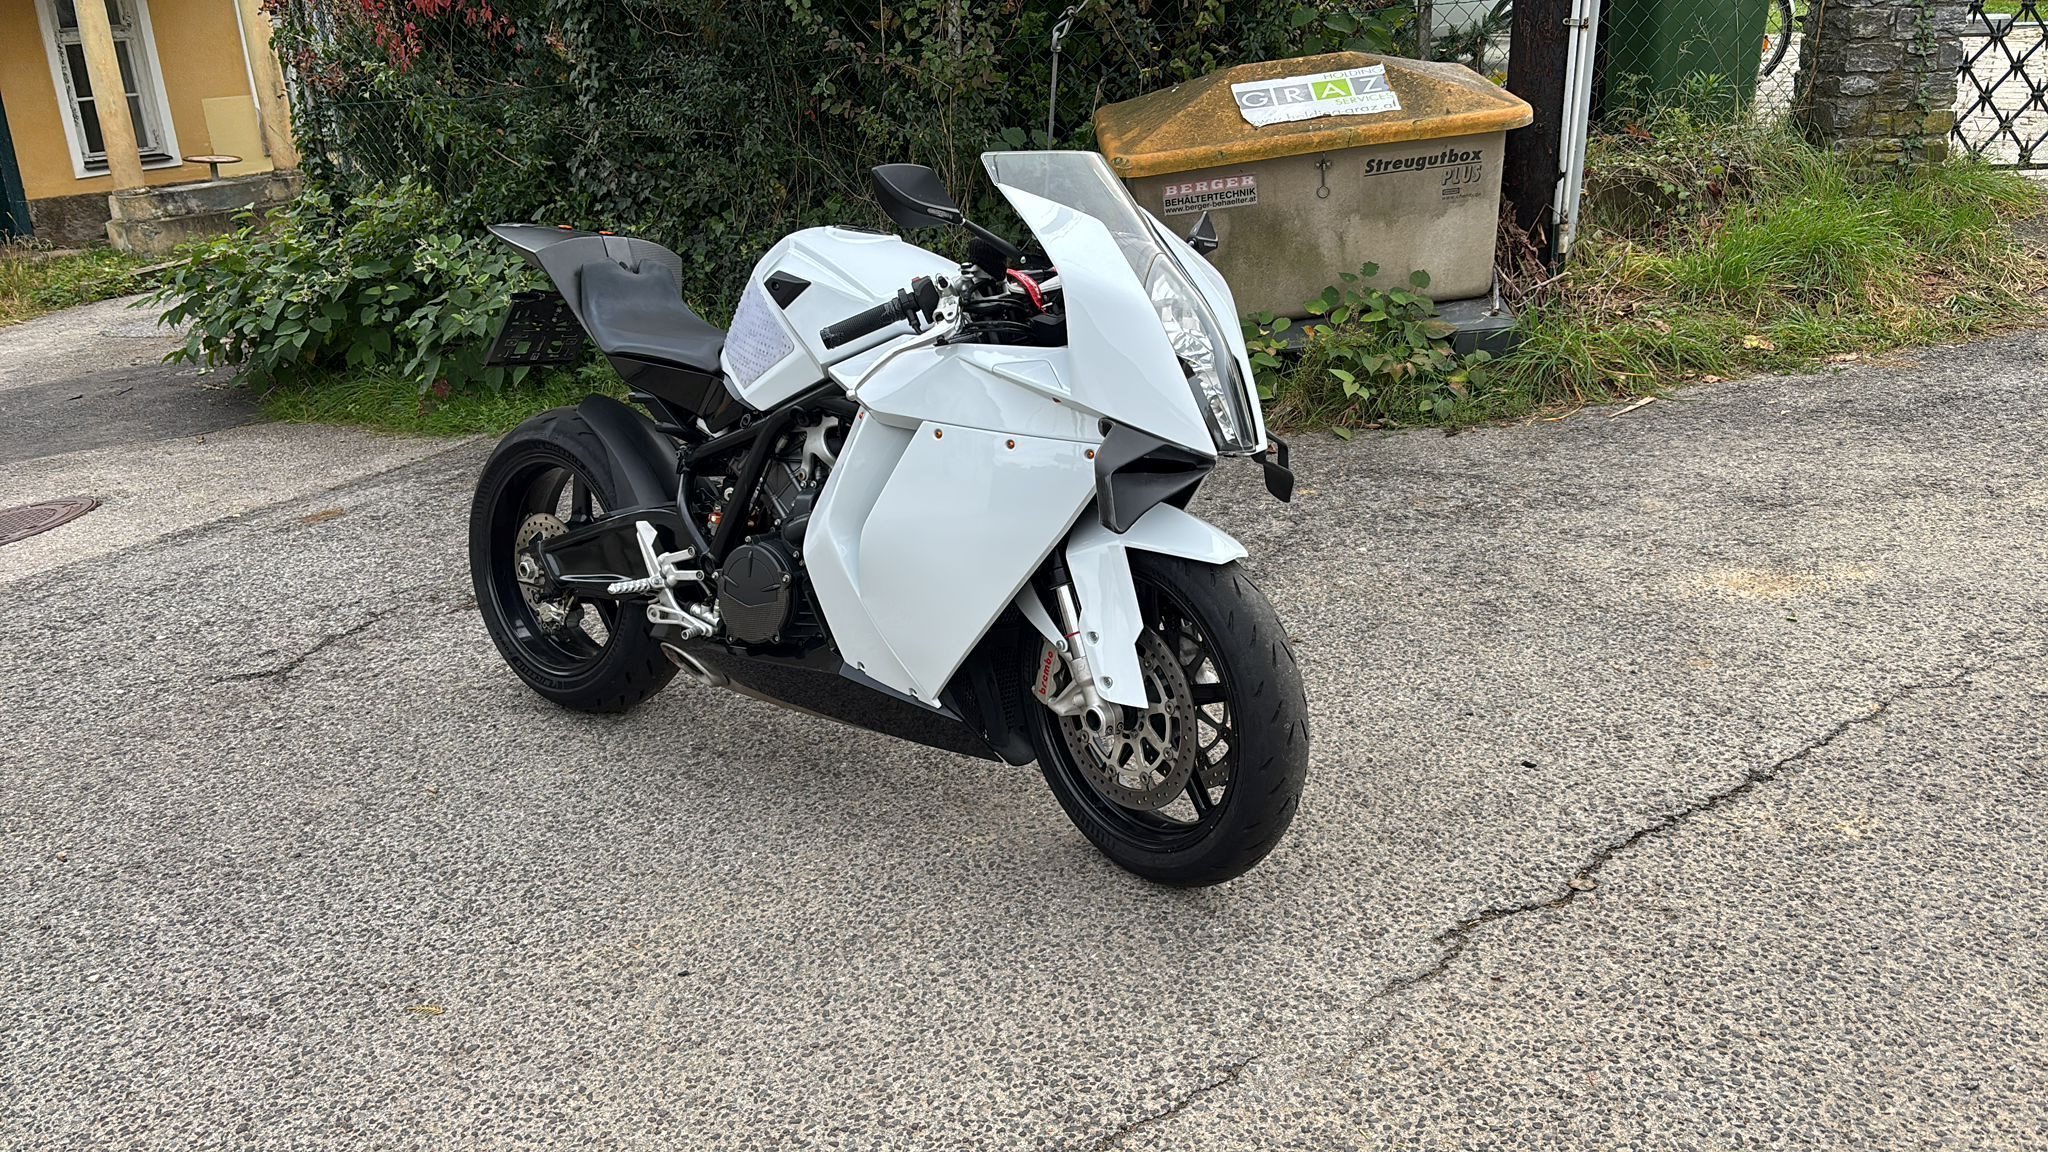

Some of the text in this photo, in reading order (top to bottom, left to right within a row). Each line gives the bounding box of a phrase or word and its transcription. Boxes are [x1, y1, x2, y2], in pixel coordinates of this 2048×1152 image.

[1323, 66, 1384, 80] HOLDING
[1241, 77, 1383, 108] GRAZ
[1335, 93, 1394, 106] SERVICES
[1365, 149, 1482, 174] Streugutbox
[1165, 176, 1255, 195] BERGER
[1441, 164, 1482, 186] PLUS
[1164, 195, 1257, 214] www.berger-behaelter.at
[1165, 187, 1256, 208] BEHÄLTERTECHNIK
[1038, 650, 1054, 695] brembo
